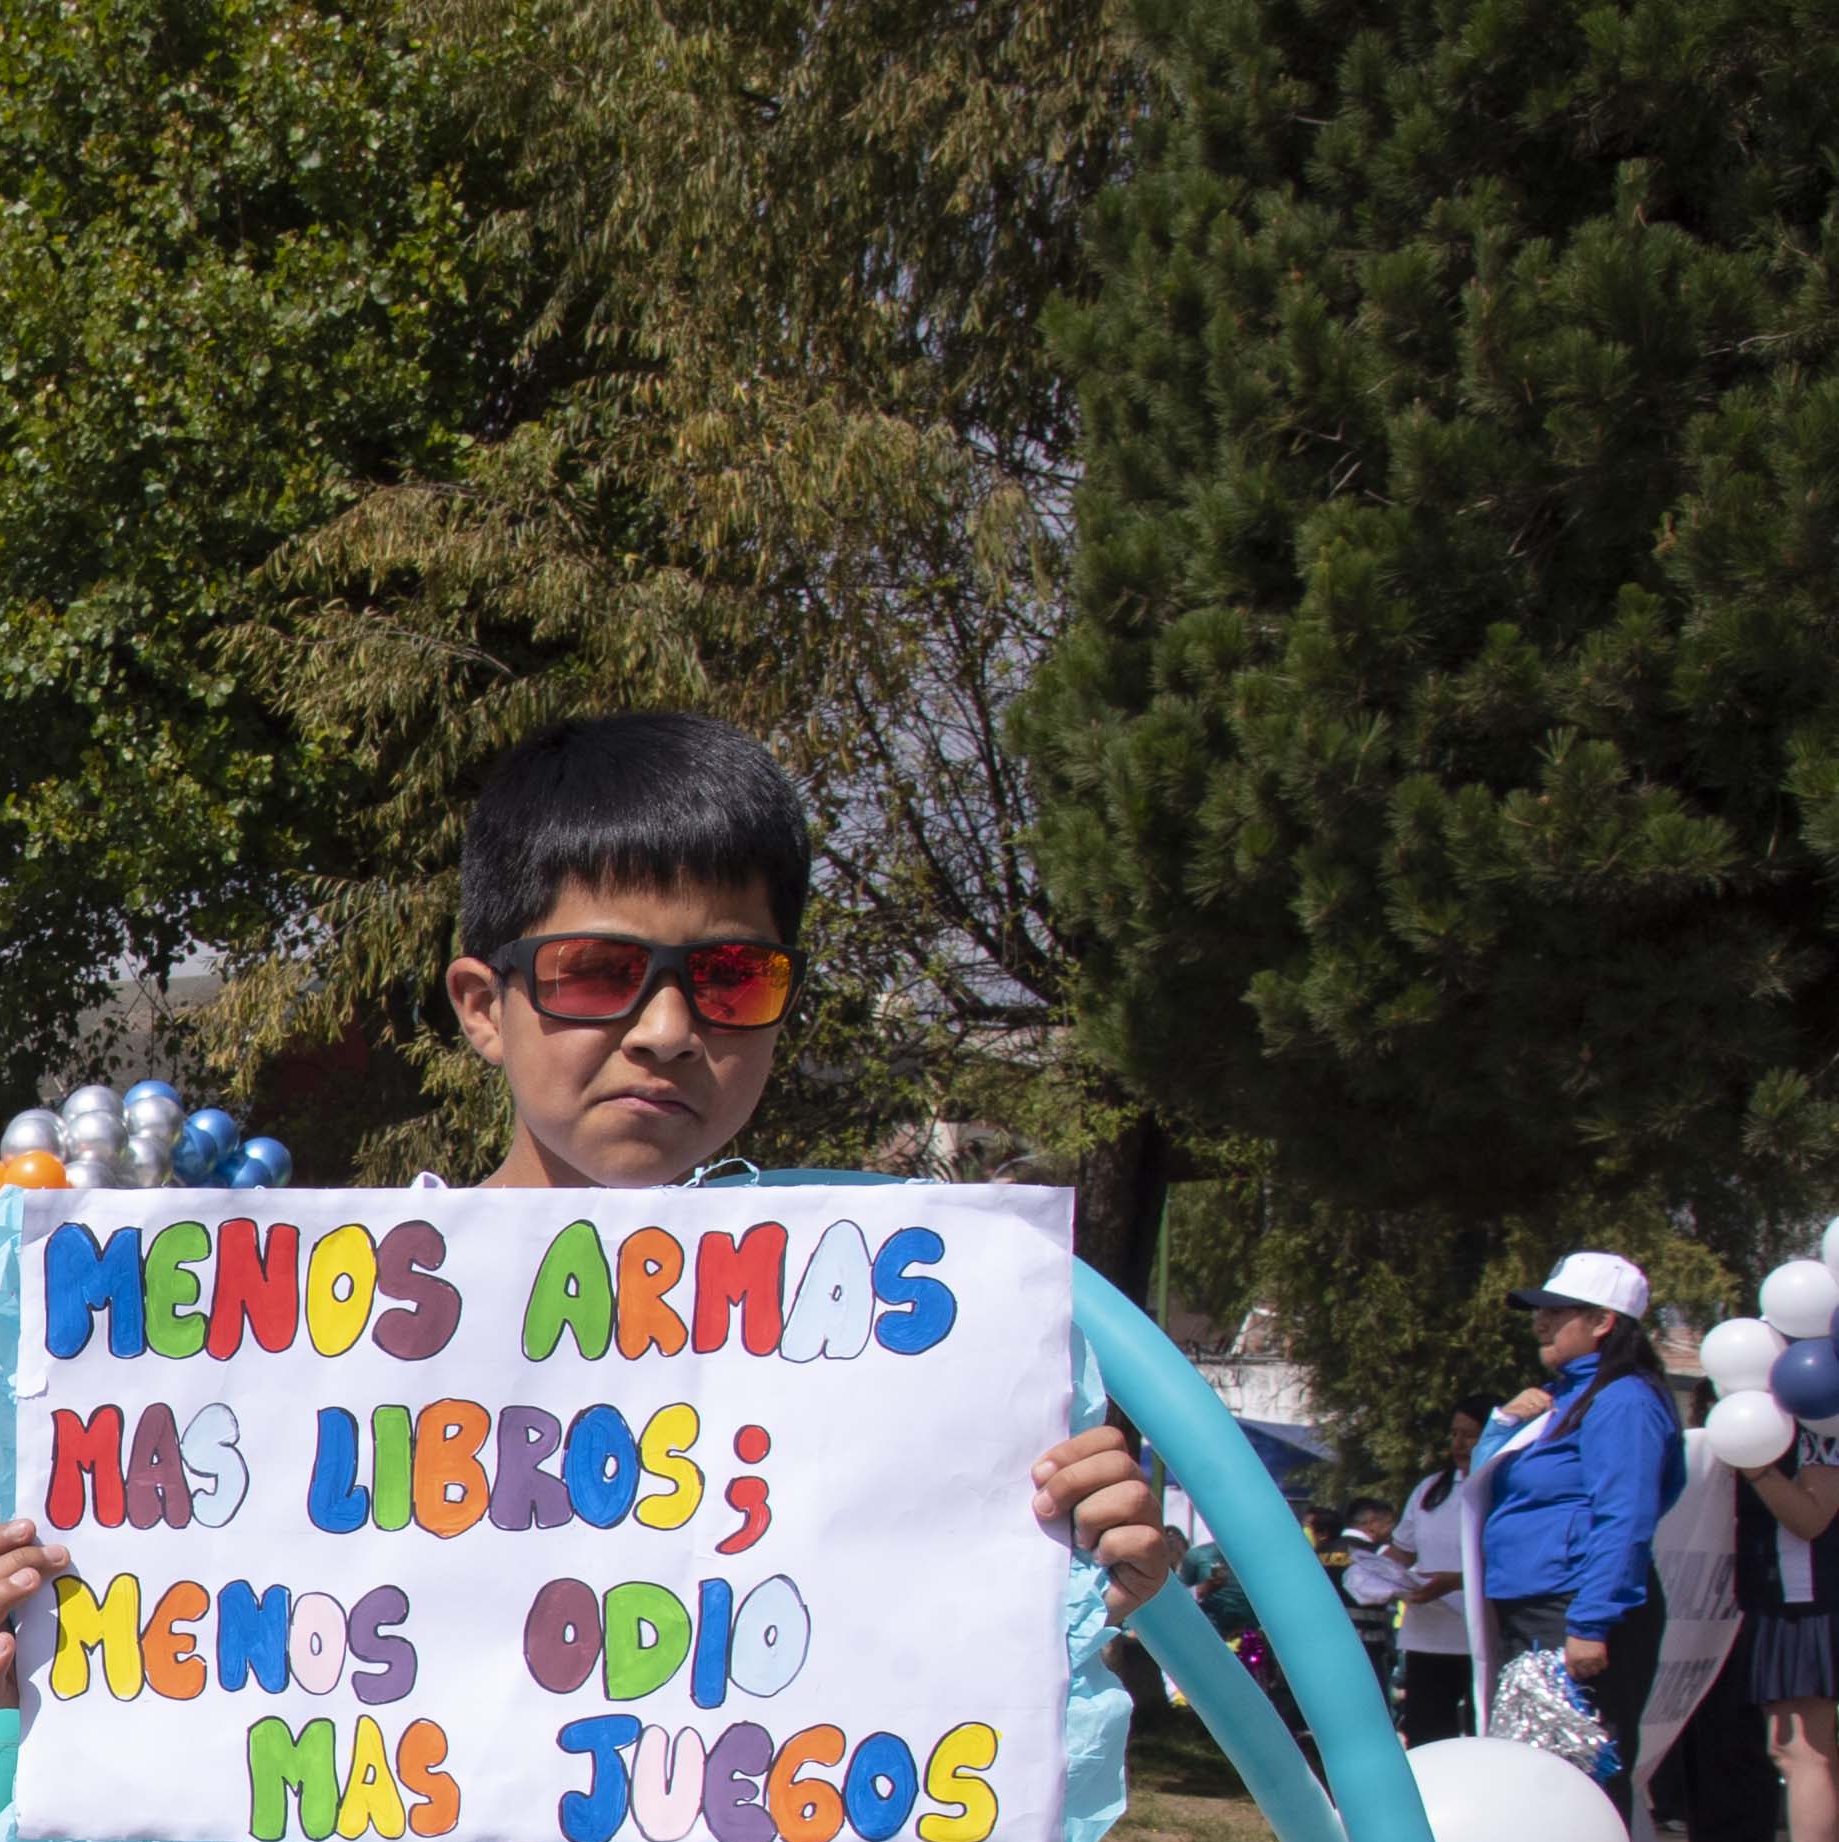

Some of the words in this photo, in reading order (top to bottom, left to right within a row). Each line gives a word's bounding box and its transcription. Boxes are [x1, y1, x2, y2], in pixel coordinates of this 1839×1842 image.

[43, 1218, 462, 1362] MENOS
[521, 1219, 958, 1363] ARMAS
[47, 1402, 248, 1532] MAS
[51, 1572, 419, 1704] MENOS
[523, 1574, 812, 1710] ODIO
[246, 1714, 461, 1841] MAS
